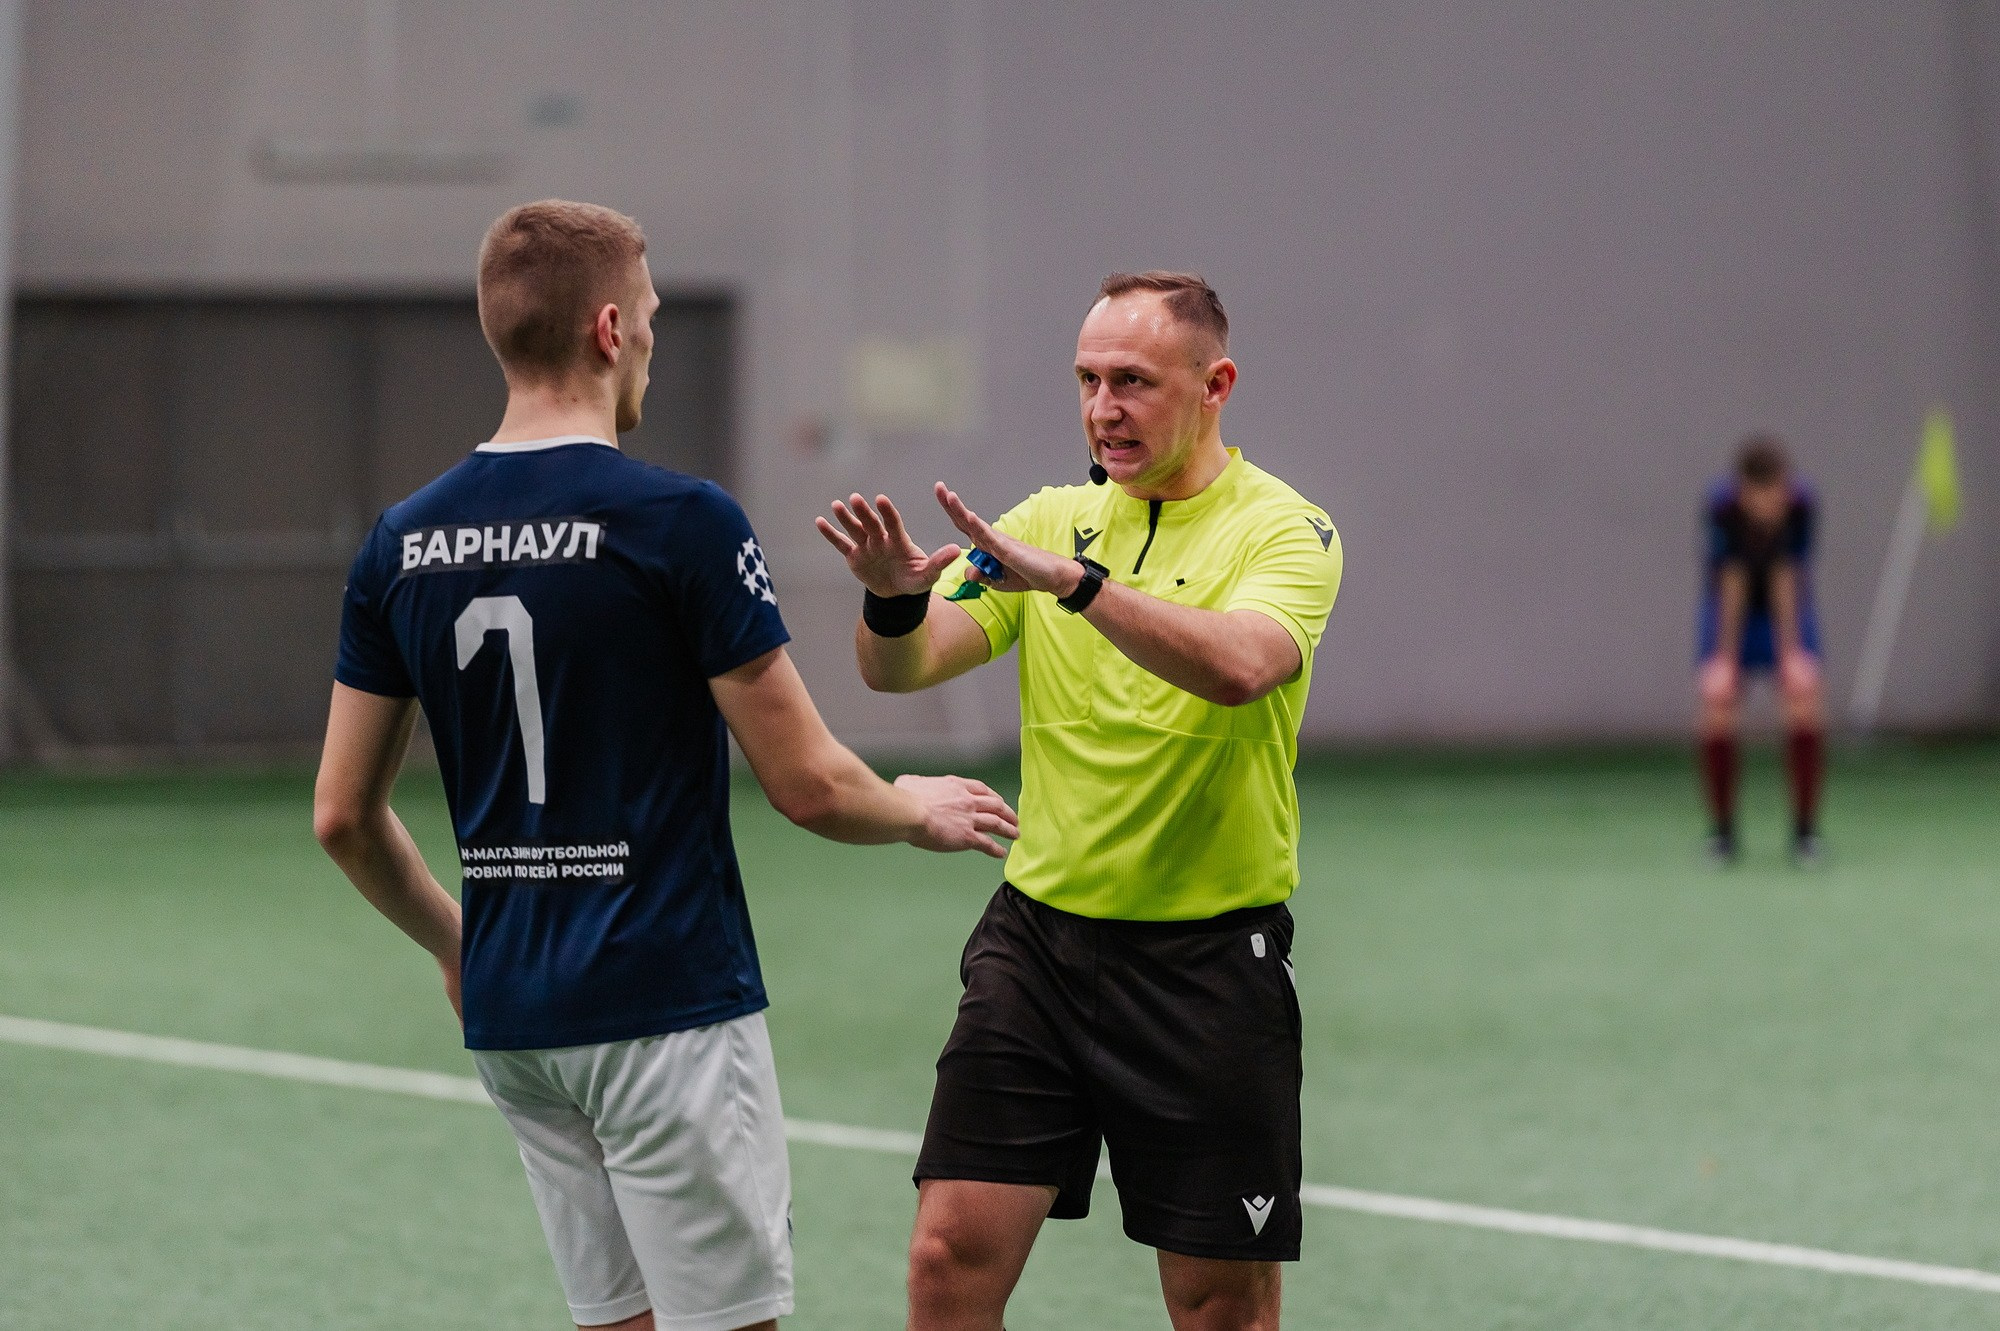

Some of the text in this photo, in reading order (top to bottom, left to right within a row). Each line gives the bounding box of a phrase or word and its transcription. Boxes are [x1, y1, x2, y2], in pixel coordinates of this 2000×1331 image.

[402, 522, 600, 570] БАРНАУЛ
[463, 866, 512, 879] РОВКИ
[514, 865, 528, 878] ПО
[561, 863, 624, 878] РОССИИ
